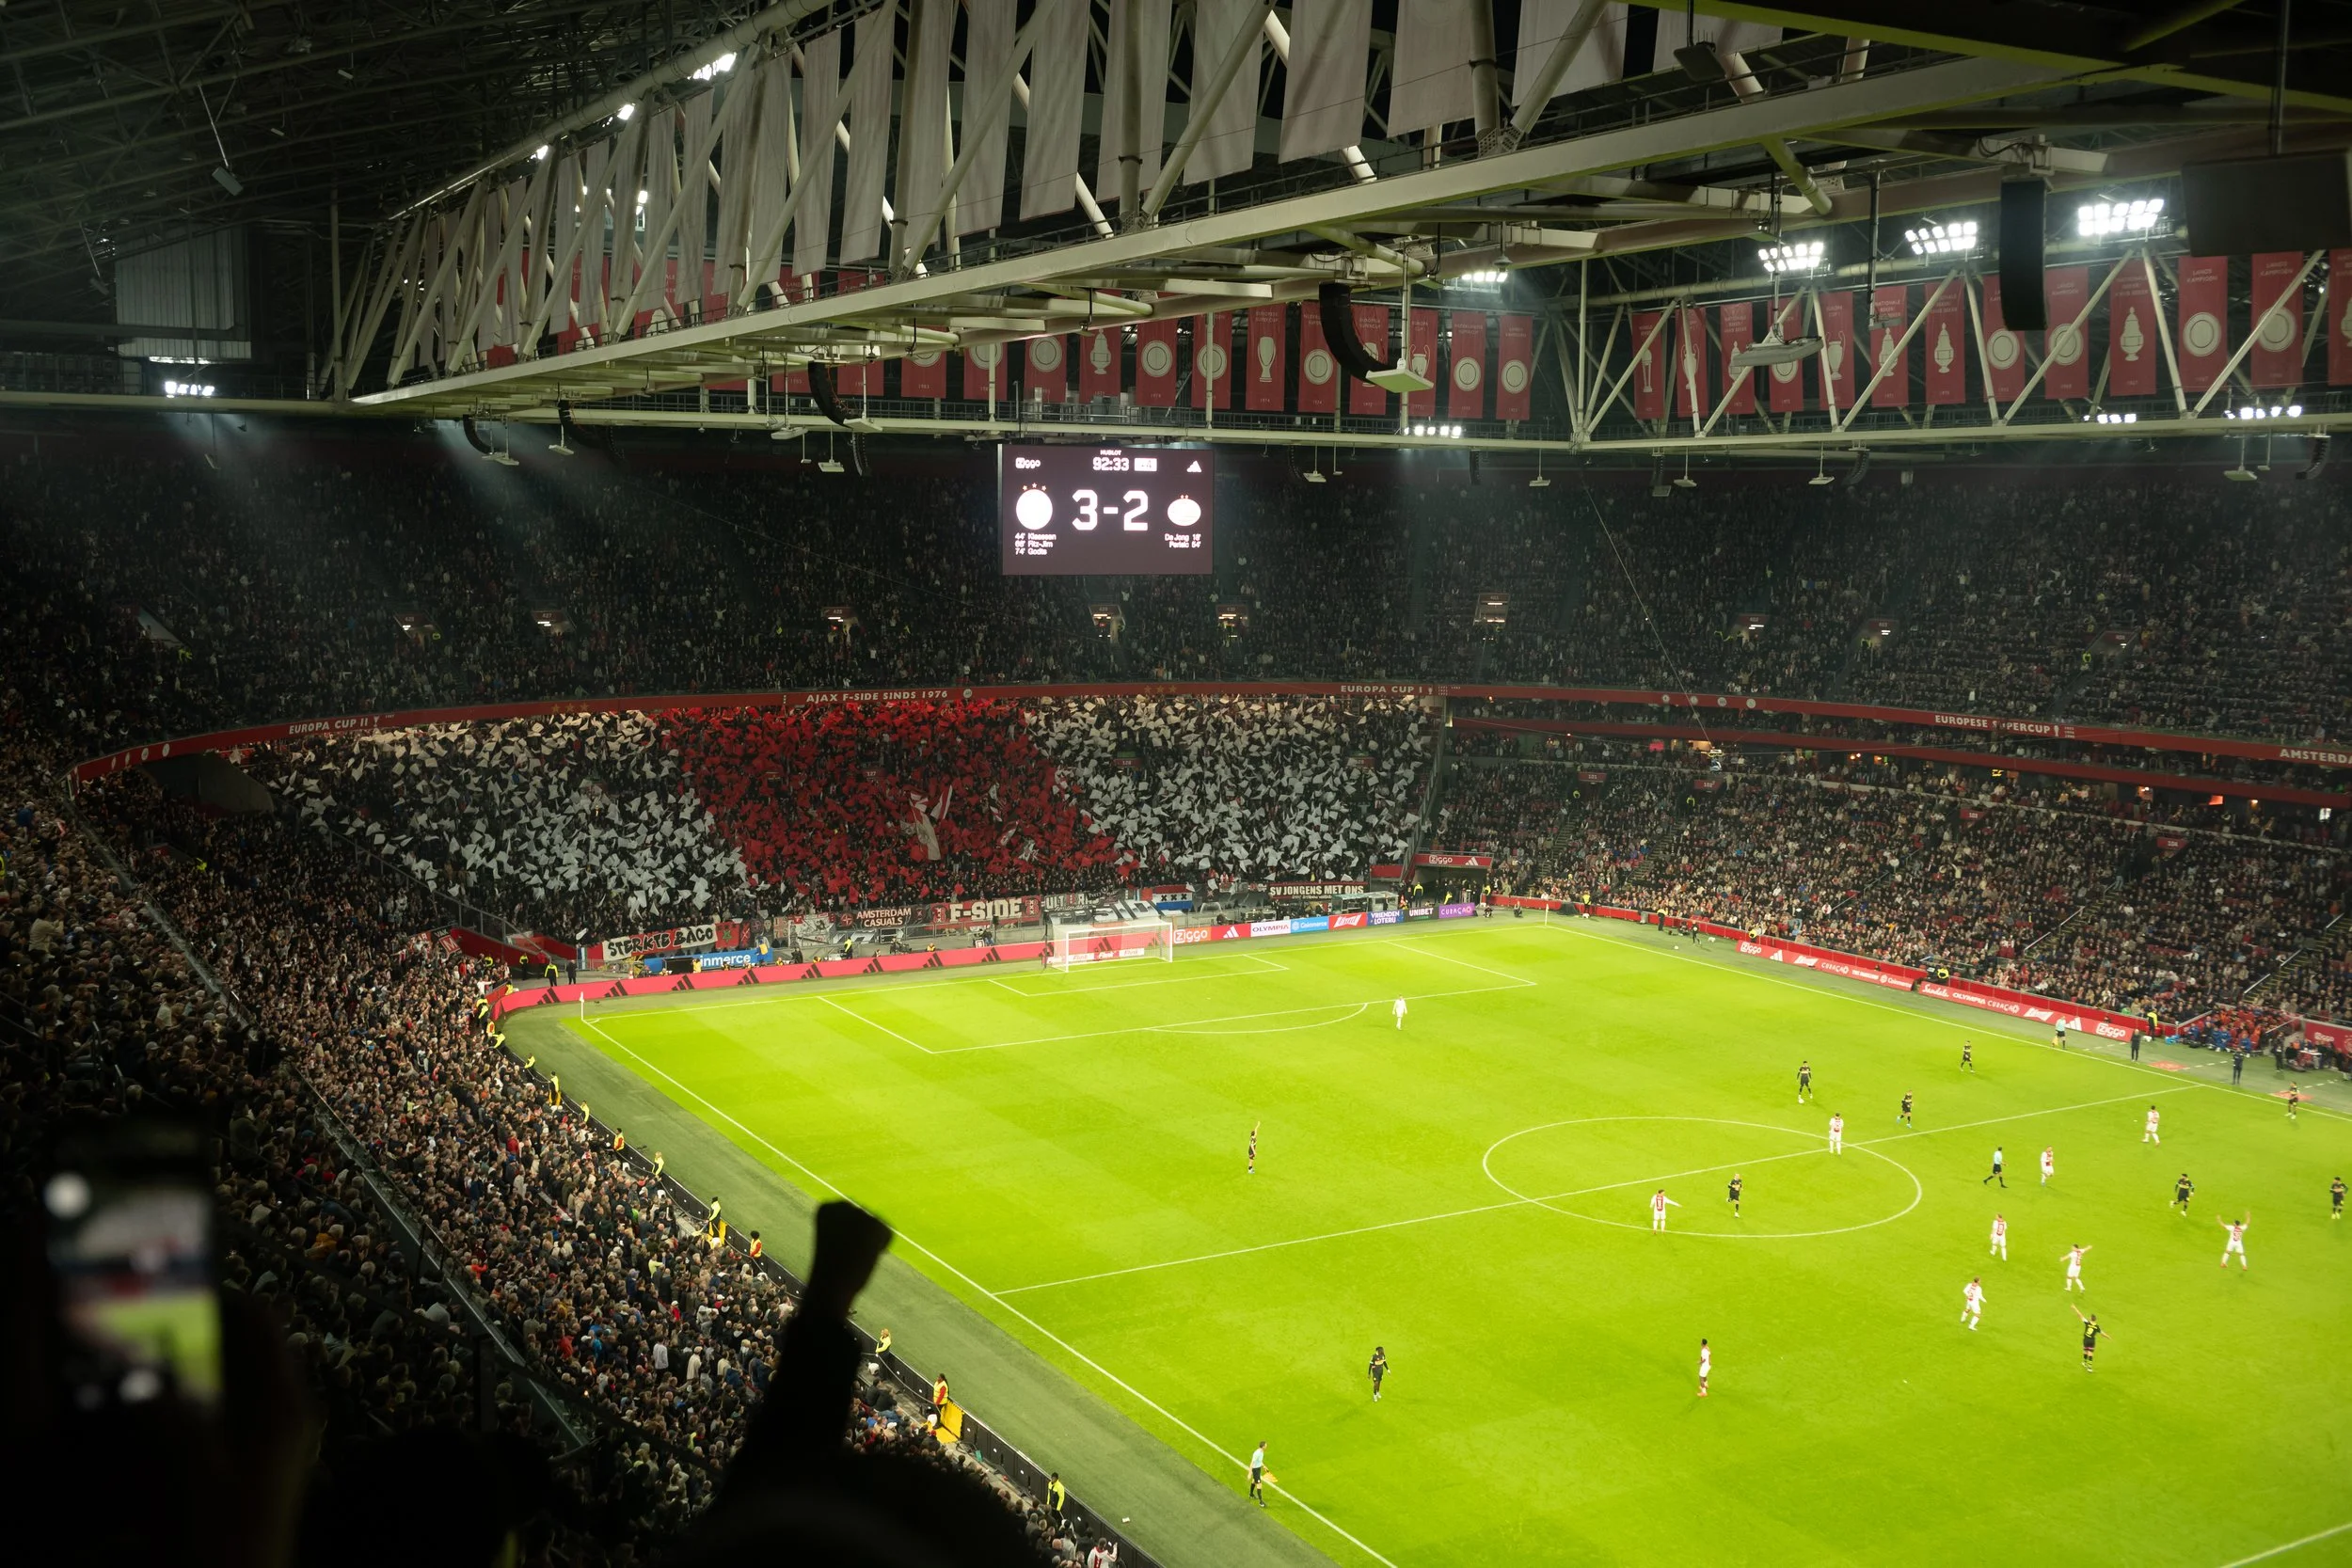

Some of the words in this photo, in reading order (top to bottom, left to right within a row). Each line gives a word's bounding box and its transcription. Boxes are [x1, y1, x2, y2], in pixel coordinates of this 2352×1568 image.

[1092, 457, 1129, 471] 92:33
[1174, 533, 1189, 543] Jong
[1341, 685, 1387, 693] EUROPA
[1391, 685, 1414, 693] CUP
[805, 693, 838, 704] AJAX
[842, 692, 879, 702] F-SIDE
[882, 691, 916, 700] SINDS
[921, 690, 947, 699] 1976
[289, 721, 330, 735] EUROPA
[334, 719, 357, 730] CUP
[1934, 714, 1988, 728] EUROPESE
[1992, 721, 2051, 735] SPERCUP
[1270, 886, 1282, 895] SV
[1282, 885, 1323, 895] JONGENS
[1324, 884, 1343, 895] MET
[1344, 884, 1364, 894] ONS
[856, 908, 911, 919] AMSTERDAM
[949, 897, 1023, 923] F-SIDE
[1370, 911, 1400, 919] VRIENDEN
[1408, 908, 1434, 917] UNIBET
[864, 917, 903, 927] CASUALS
[1252, 924, 1289, 933] OLYMPIA
[608, 931, 671, 957] STERKTE
[1952, 992, 1986, 1005] OLYMPIA
